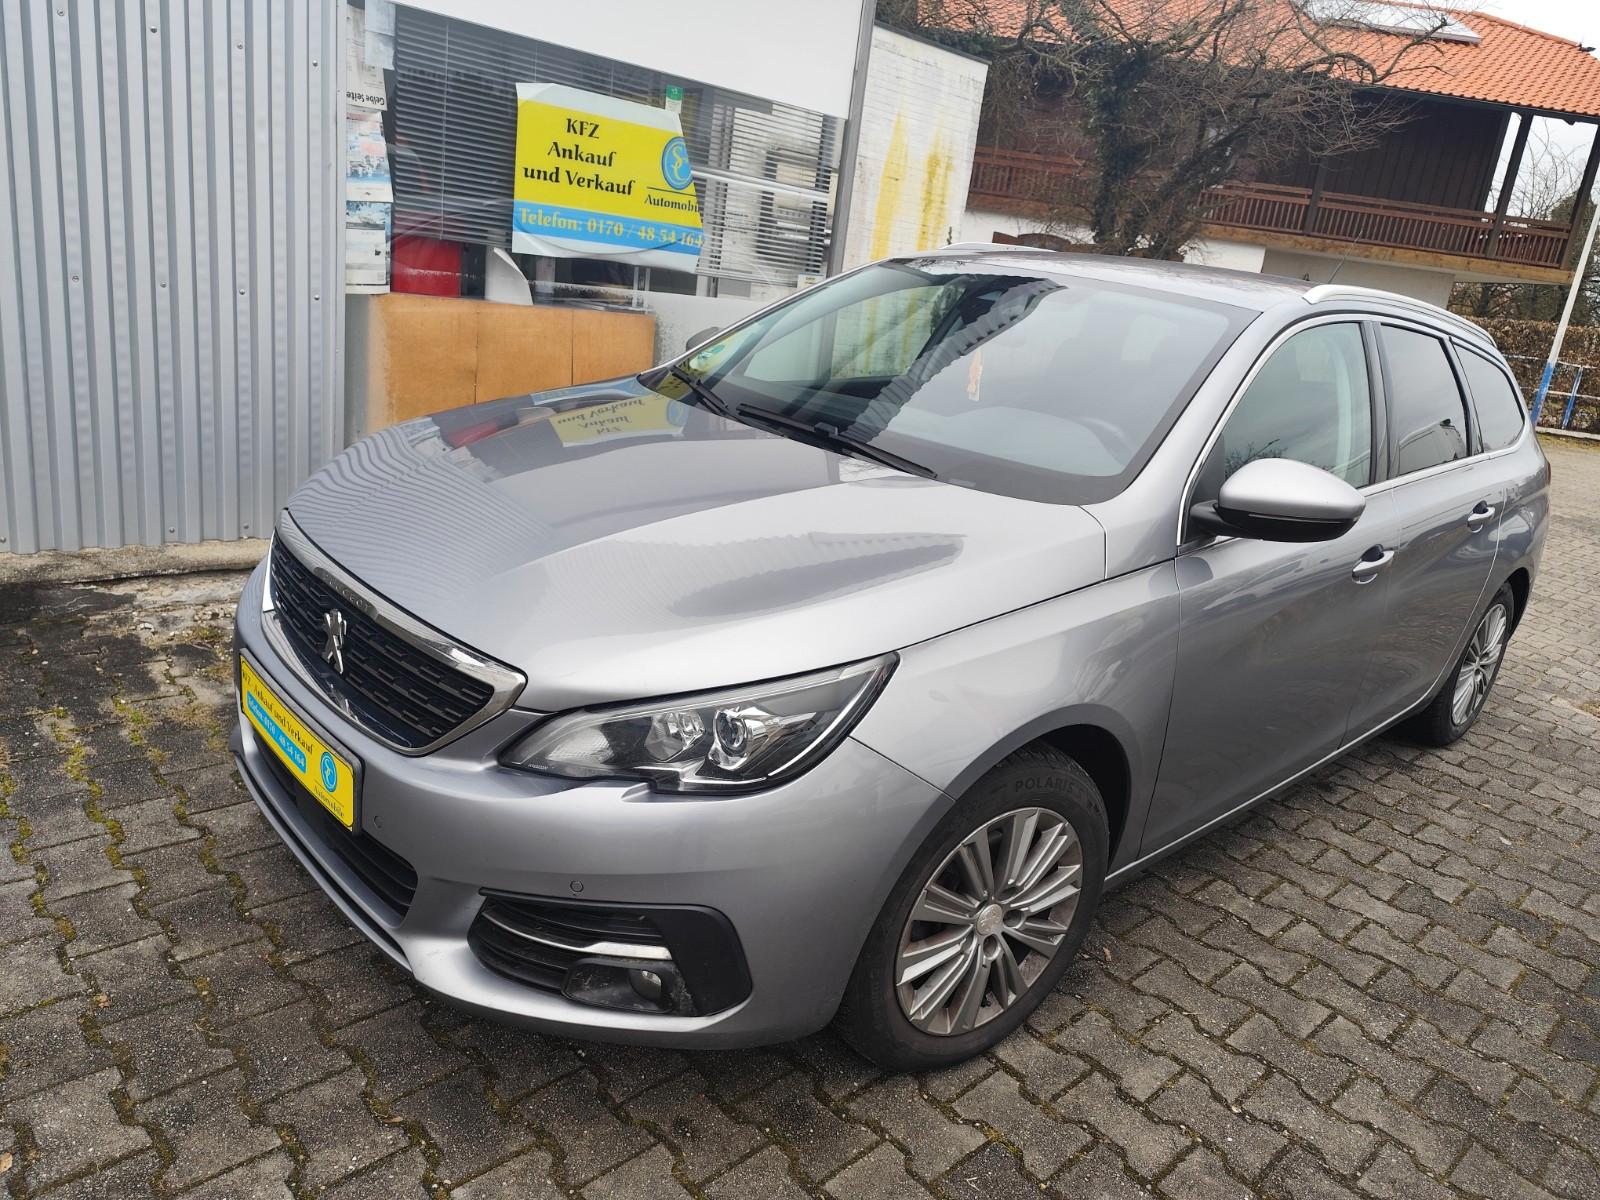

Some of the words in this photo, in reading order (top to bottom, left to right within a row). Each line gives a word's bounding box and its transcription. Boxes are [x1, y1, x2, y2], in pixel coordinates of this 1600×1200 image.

[365, 95, 385, 106] Gelbe
[566, 118, 600, 139] KFZ
[548, 141, 617, 167] Ankauf
[523, 166, 560, 184] und
[565, 170, 636, 196] Verkauf
[518, 207, 583, 232] Telefon:
[587, 218, 624, 236] 0170
[638, 225, 655, 241] 48
[659, 228, 677, 243] 54
[680, 232, 703, 248] 164
[274, 709, 286, 727] und
[286, 720, 314, 755] Verkauf
[1015, 775, 1076, 793] POLARIS
